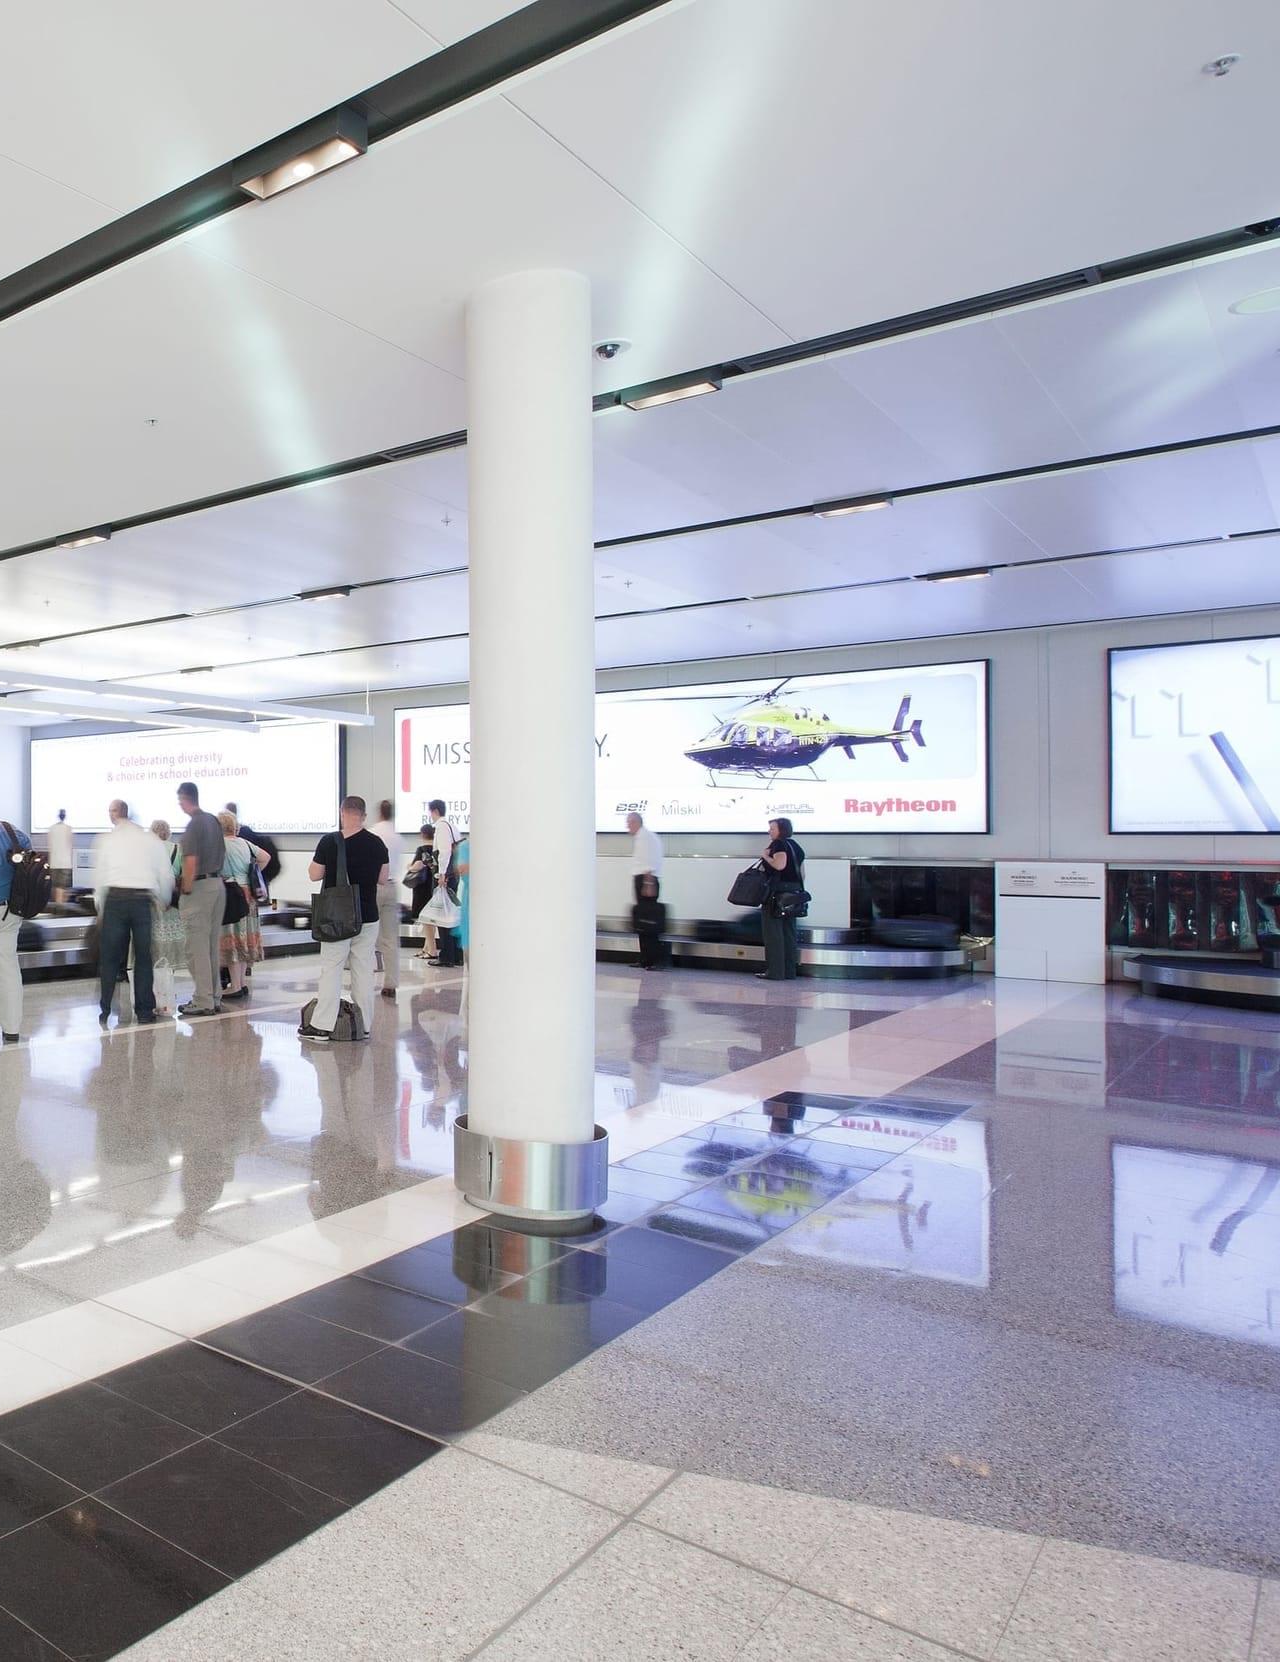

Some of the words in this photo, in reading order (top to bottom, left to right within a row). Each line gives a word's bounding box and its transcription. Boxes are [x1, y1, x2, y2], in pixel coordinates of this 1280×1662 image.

[119, 754, 176, 767] Celebrating
[177, 751, 223, 764] diversity
[423, 742, 471, 765] MISS
[116, 770, 145, 782] choice
[148, 770, 158, 781] in
[159, 768, 193, 780] school
[194, 766, 249, 778] education
[844, 798, 957, 816] Raytheon
[258, 821, 299, 830] Education
[302, 821, 328, 830] Union
